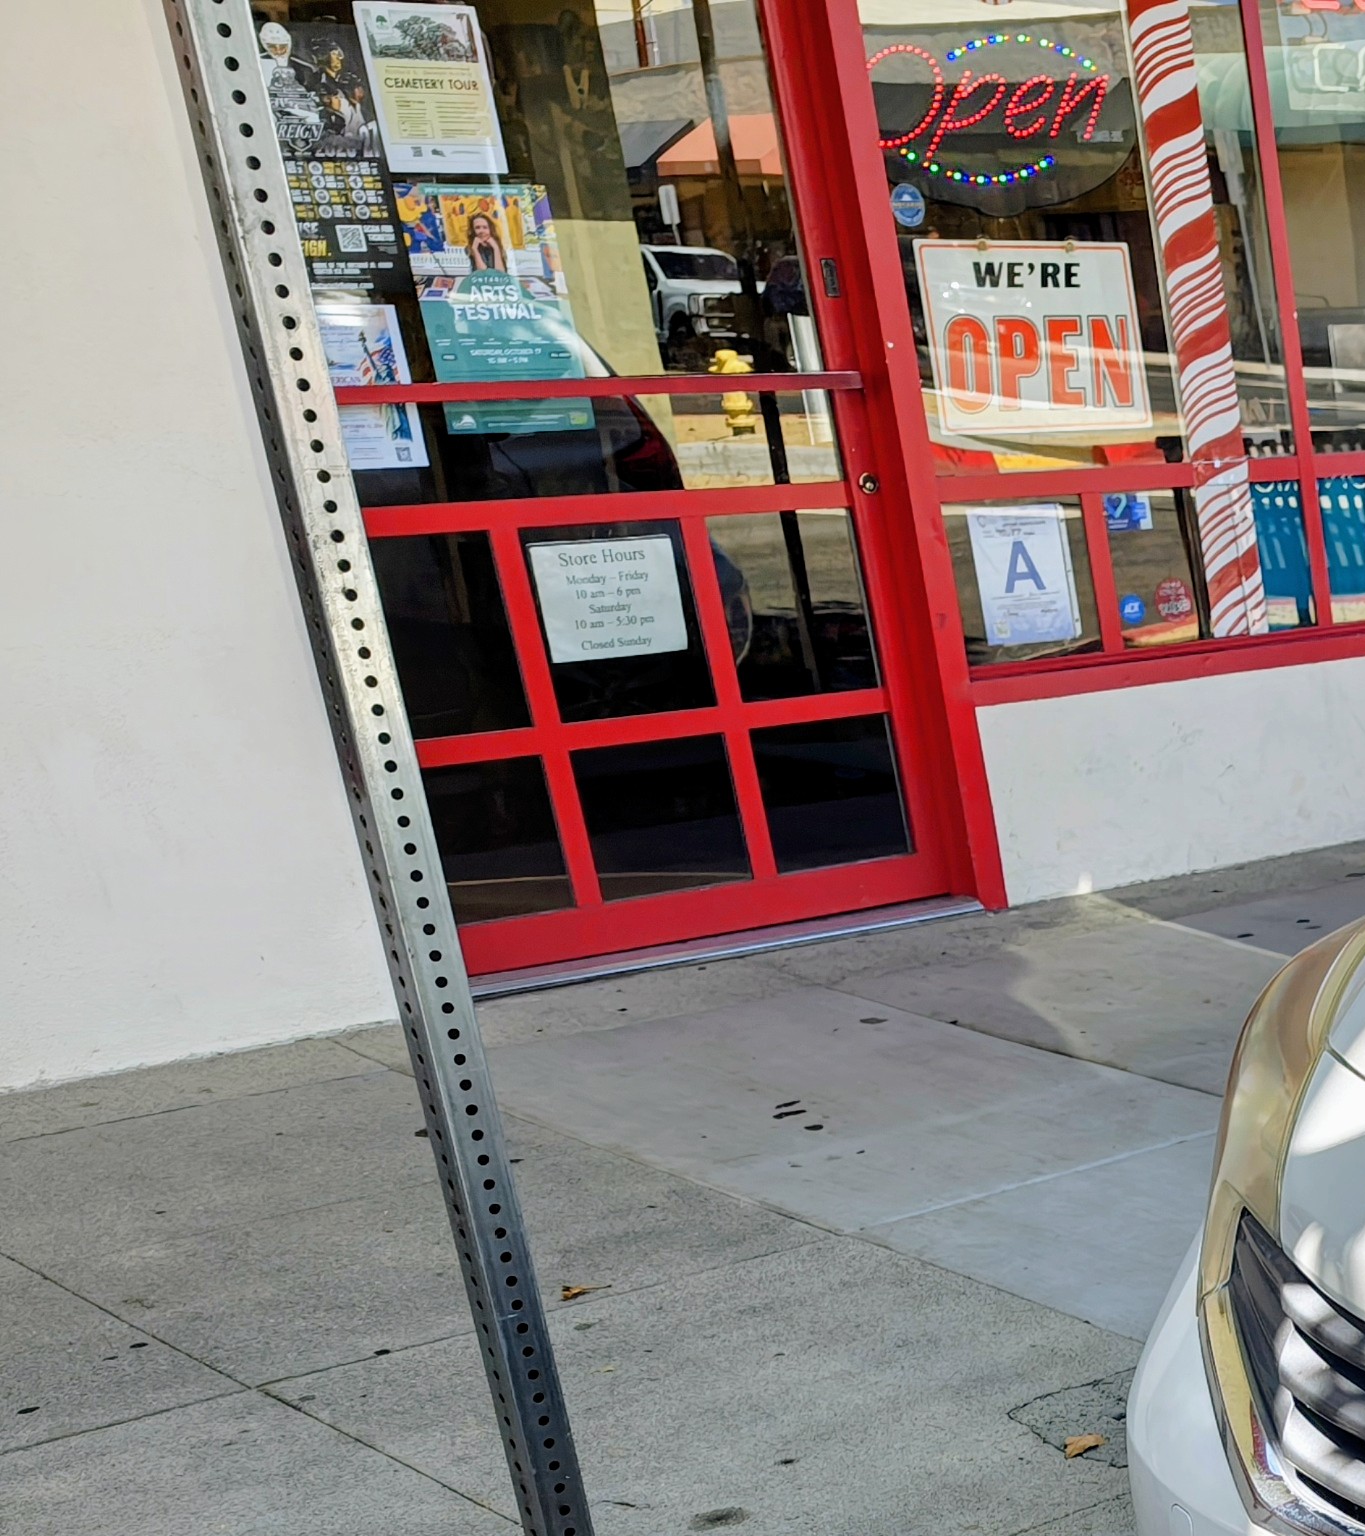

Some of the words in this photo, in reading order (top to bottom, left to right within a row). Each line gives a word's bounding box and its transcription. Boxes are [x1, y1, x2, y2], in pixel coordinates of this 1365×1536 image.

[384, 77, 444, 90] CEMETERY
[448, 78, 479, 91] TOUR
[866, 44, 1111, 160] Open
[277, 124, 320, 139] REIGN
[973, 262, 1081, 288] WE'RE
[469, 284, 519, 301] ARTS
[452, 302, 542, 321] FESTIVAL
[943, 313, 1134, 414] OPEN
[558, 552, 597, 567] Store
[602, 549, 645, 564] Hours
[1005, 540, 1046, 593] A
[566, 573, 606, 585] Monday
[618, 571, 649, 583] Friday
[576, 590, 587, 599] 10
[590, 590, 605, 598] am
[616, 587, 623, 596] 6
[626, 588, 641, 598] pm
[589, 602, 632, 614] Saturday
[575, 620, 587, 630] 10
[590, 620, 605, 629] am
[616, 615, 637, 627] 5:30
[640, 615, 655, 626] pm
[581, 637, 615, 651] Closed
[617, 635, 652, 648] Sunday
